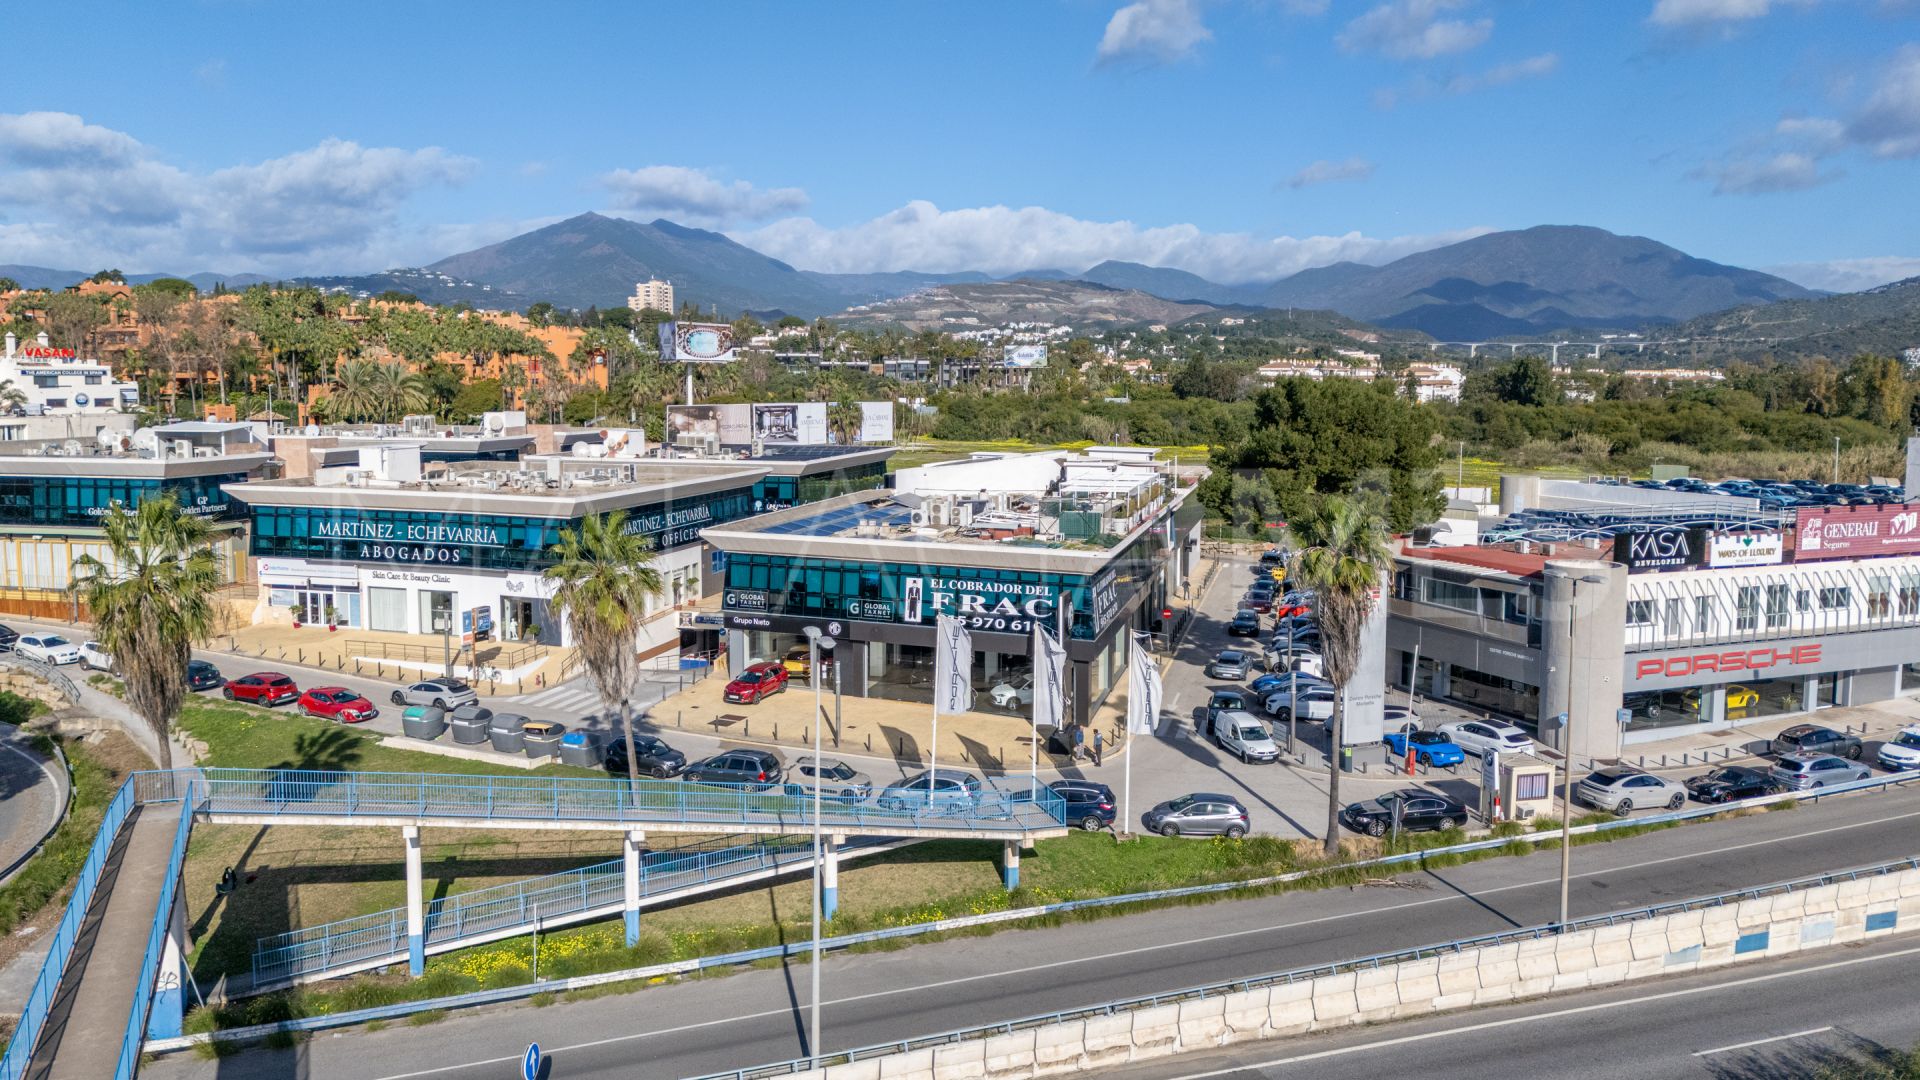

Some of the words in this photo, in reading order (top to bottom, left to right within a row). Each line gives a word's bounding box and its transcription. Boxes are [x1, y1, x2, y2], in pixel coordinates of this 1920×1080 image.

[201, 504, 227, 513] Partners
[667, 502, 710, 527] ECHEVARRÍA
[318, 519, 394, 539] MARTÍNEZ
[407, 525, 498, 544] ECHEVARRÍA
[662, 527, 699, 547] OFFICES
[1824, 521, 1879, 538] GENERALI
[1631, 532, 1690, 559] KASA
[1718, 549, 1738, 559] WAYS
[1739, 549, 1749, 558] OF
[1750, 547, 1776, 557] LUXURY
[1823, 540, 1850, 551] Seguros
[361, 545, 461, 562] ABOGADOS
[1634, 557, 1686, 567] DEVELOPERS
[372, 571, 386, 579] Skin
[387, 572, 401, 580] Care
[410, 573, 430, 584] Beauty
[431, 574, 451, 583] Clinic
[930, 579, 946, 589] EL
[949, 579, 1023, 595] COBRADOR
[1025, 585, 1052, 597] DEL
[740, 593, 765, 601] GLOBAL
[930, 591, 1053, 618] FRAC
[864, 603, 890, 611] GLOBAL
[733, 616, 752, 626] Grupo
[753, 617, 770, 626] Nieto
[973, 616, 1006, 630] 970
[1635, 643, 1823, 681] PORSCHE
